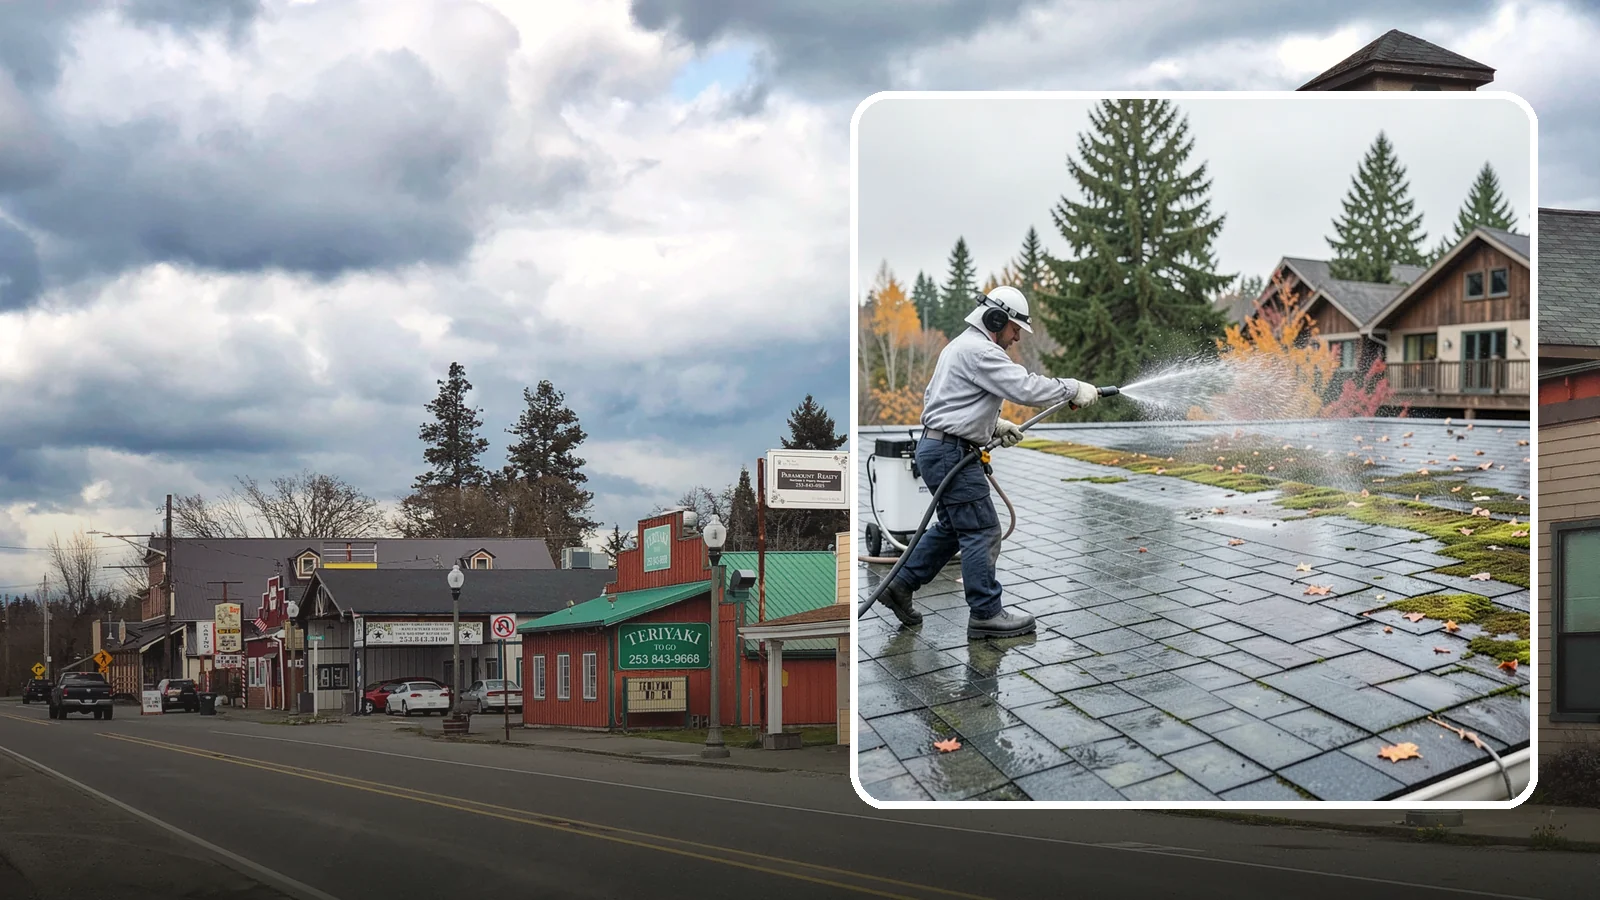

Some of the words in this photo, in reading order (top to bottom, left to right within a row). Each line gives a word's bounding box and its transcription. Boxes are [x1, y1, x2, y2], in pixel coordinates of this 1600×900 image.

[817, 472, 839, 480] REALTY
[625, 627, 702, 646] TERIYAKI
[629, 654, 648, 664] 253
[651, 654, 700, 664] 843-9668
[639, 681, 672, 690] TERIYAKI
